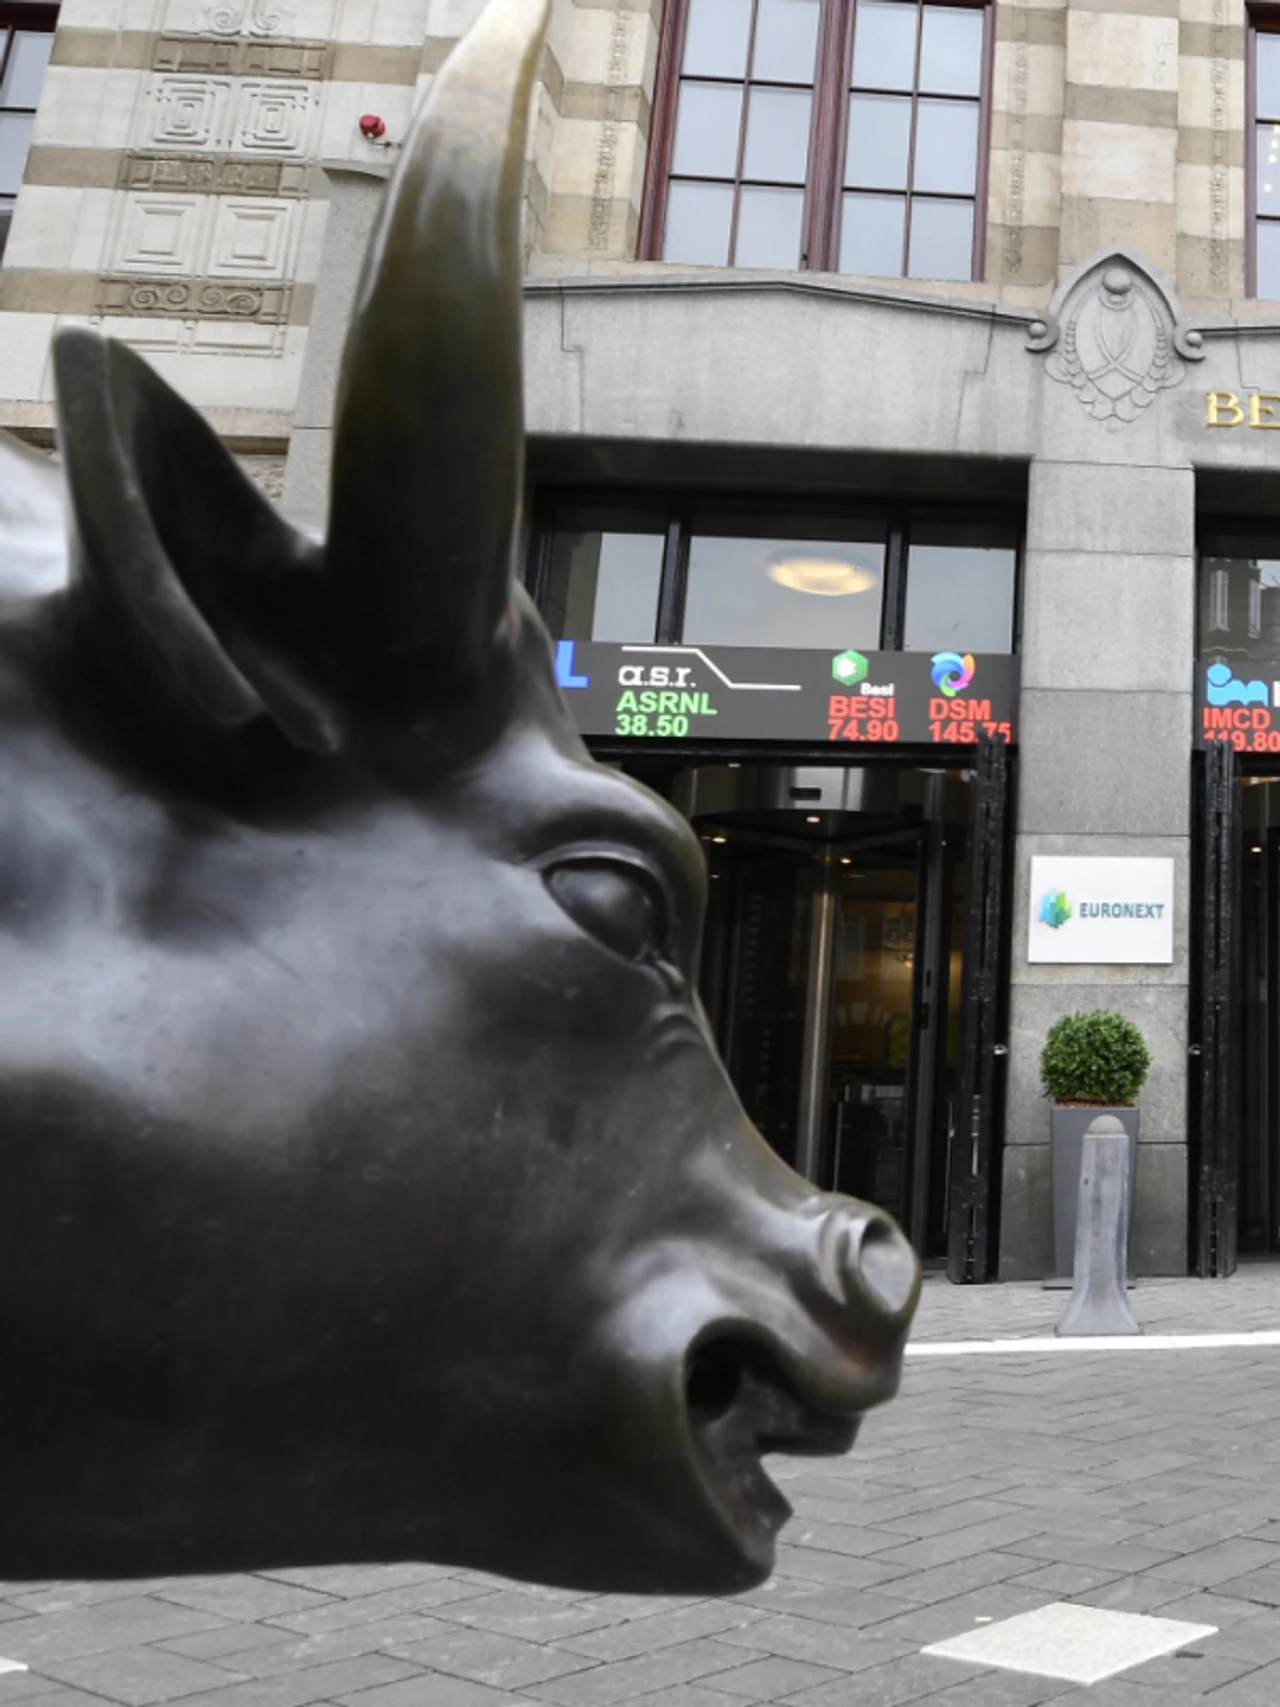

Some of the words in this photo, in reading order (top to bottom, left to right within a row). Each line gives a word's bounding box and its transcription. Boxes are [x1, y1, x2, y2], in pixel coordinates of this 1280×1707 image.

[860, 682, 895, 697] Besi
[615, 690, 719, 716] ASRNL
[828, 694, 896, 719] BESI
[928, 697, 992, 721] DSM
[615, 714, 690, 738] 38.50
[1202, 706, 1272, 730] IMCD
[827, 718, 900, 743] 74.90
[1079, 902, 1165, 919] EURONEXT
